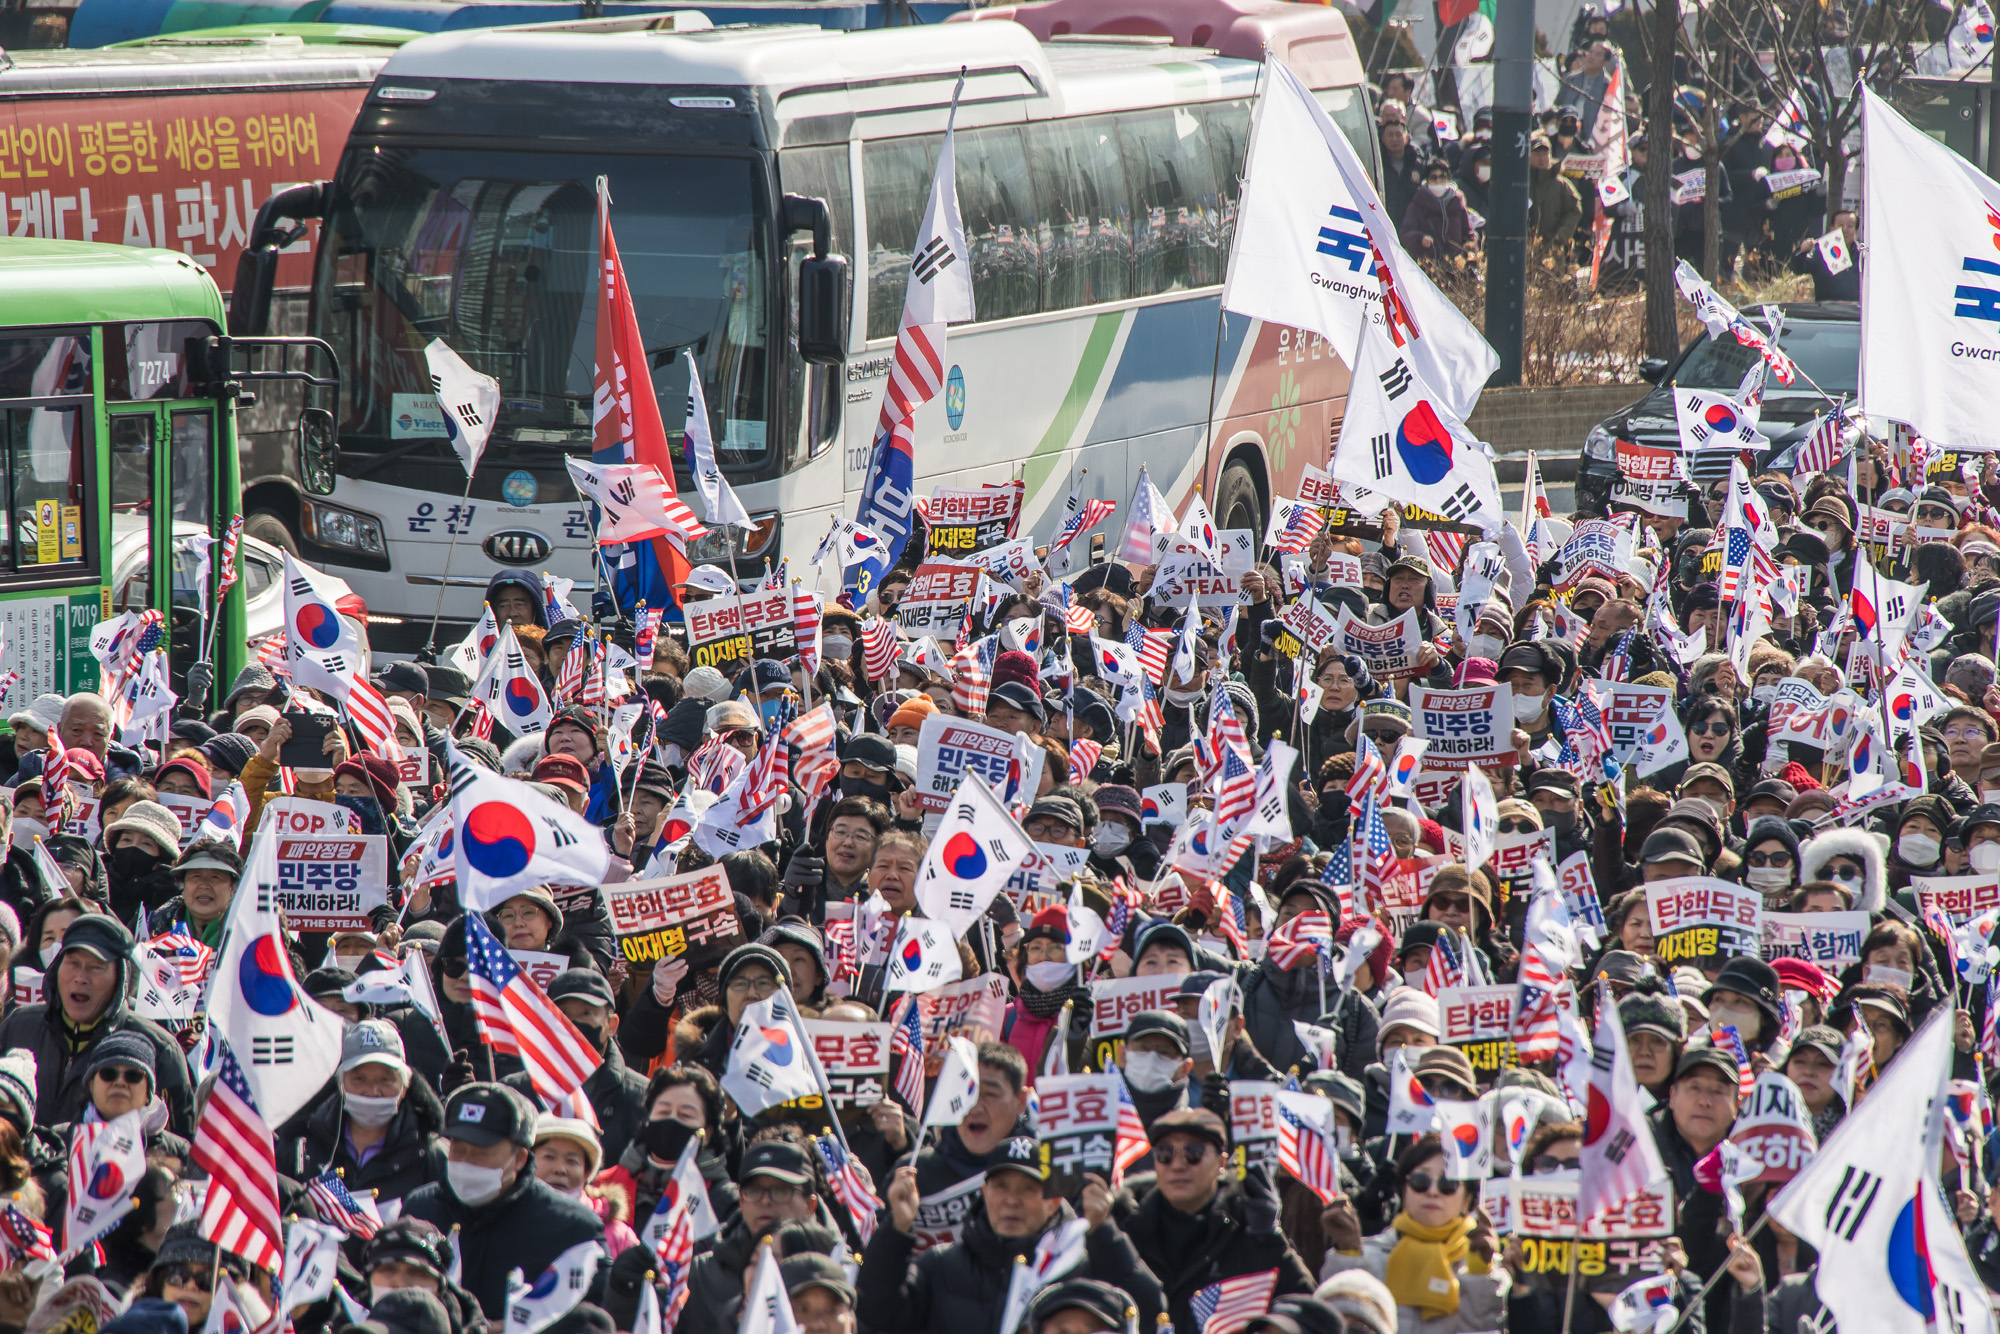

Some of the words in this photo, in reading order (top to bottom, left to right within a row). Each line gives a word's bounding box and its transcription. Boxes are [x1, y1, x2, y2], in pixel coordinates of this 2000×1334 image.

[78, 119, 158, 177] 평등한
[164, 114, 242, 172] 세상을
[245, 112, 322, 168] 위하여
[139, 361, 169, 384] 7274
[930, 494, 1011, 521] 탄핵무효
[977, 521, 1006, 546] 구속
[1563, 533, 1616, 560] 민주당
[494, 536, 541, 558] KIA
[992, 555, 1014, 584] THE
[1008, 546, 1030, 579] STOP
[1564, 548, 1616, 573] 해체하라!
[1567, 570, 1582, 586] STOP
[71, 603, 99, 628] 7019
[691, 595, 789, 641] 탄핵무효
[1349, 623, 1398, 641] 패악정당
[696, 635, 754, 667] 이재명
[756, 626, 795, 653] 구속
[1344, 634, 1406, 659] 민주당
[1428, 694, 1487, 711] 패악정당
[1423, 710, 1493, 736] 민주당
[948, 730, 1014, 756] 패악정당
[937, 747, 1011, 784] 민주당
[1421, 758, 1445, 768] STOP
[1447, 760, 1466, 768] THE
[1473, 757, 1501, 767] TEAL
[286, 842, 357, 859] 패악정당
[278, 863, 362, 891] 민주당
[277, 893, 360, 911] 해체하라!
[611, 873, 727, 929] 탄핵무효
[1655, 890, 1758, 930] 탄핵무효
[303, 919, 326, 928] THE
[327, 919, 366, 928] STEAL
[622, 926, 687, 962] 이재명
[687, 911, 739, 946] 구속
[1657, 927, 1719, 962] 이재명
[1812, 930, 1860, 960] 함께
[927, 990, 982, 1016] STOP
[932, 1012, 968, 1035] THE
[829, 1077, 884, 1111] 구속
[1038, 1086, 1109, 1131] 무효
[1007, 1137, 1032, 1160] NY
[1053, 1134, 1112, 1176] 구속
[1521, 1239, 1607, 1276] 이재명
[1609, 1240, 1665, 1276] 구속
